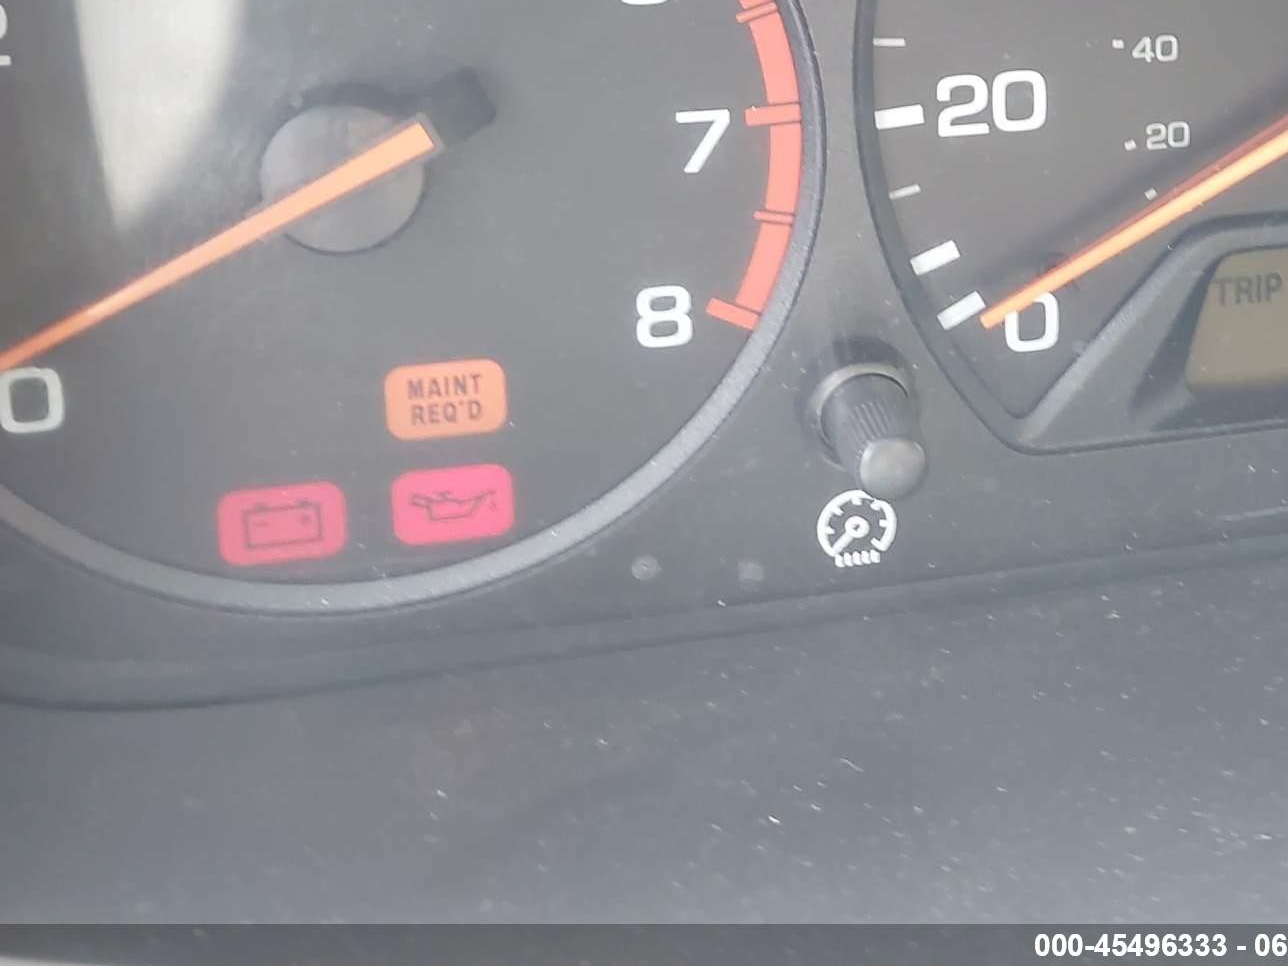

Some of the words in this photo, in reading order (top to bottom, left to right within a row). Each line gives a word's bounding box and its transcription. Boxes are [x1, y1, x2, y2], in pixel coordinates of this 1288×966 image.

[1131, 35, 1178, 63] 40
[936, 70, 1047, 138] 20
[675, 109, 731, 174] 7
[1145, 121, 1190, 150] 20
[1213, 272, 1284, 308] TRIP
[636, 285, 693, 348] 8
[1004, 291, 1059, 353] 0
[1, 365, 65, 433] 0
[406, 373, 483, 400] MAINT
[410, 399, 483, 427] REQ'D
